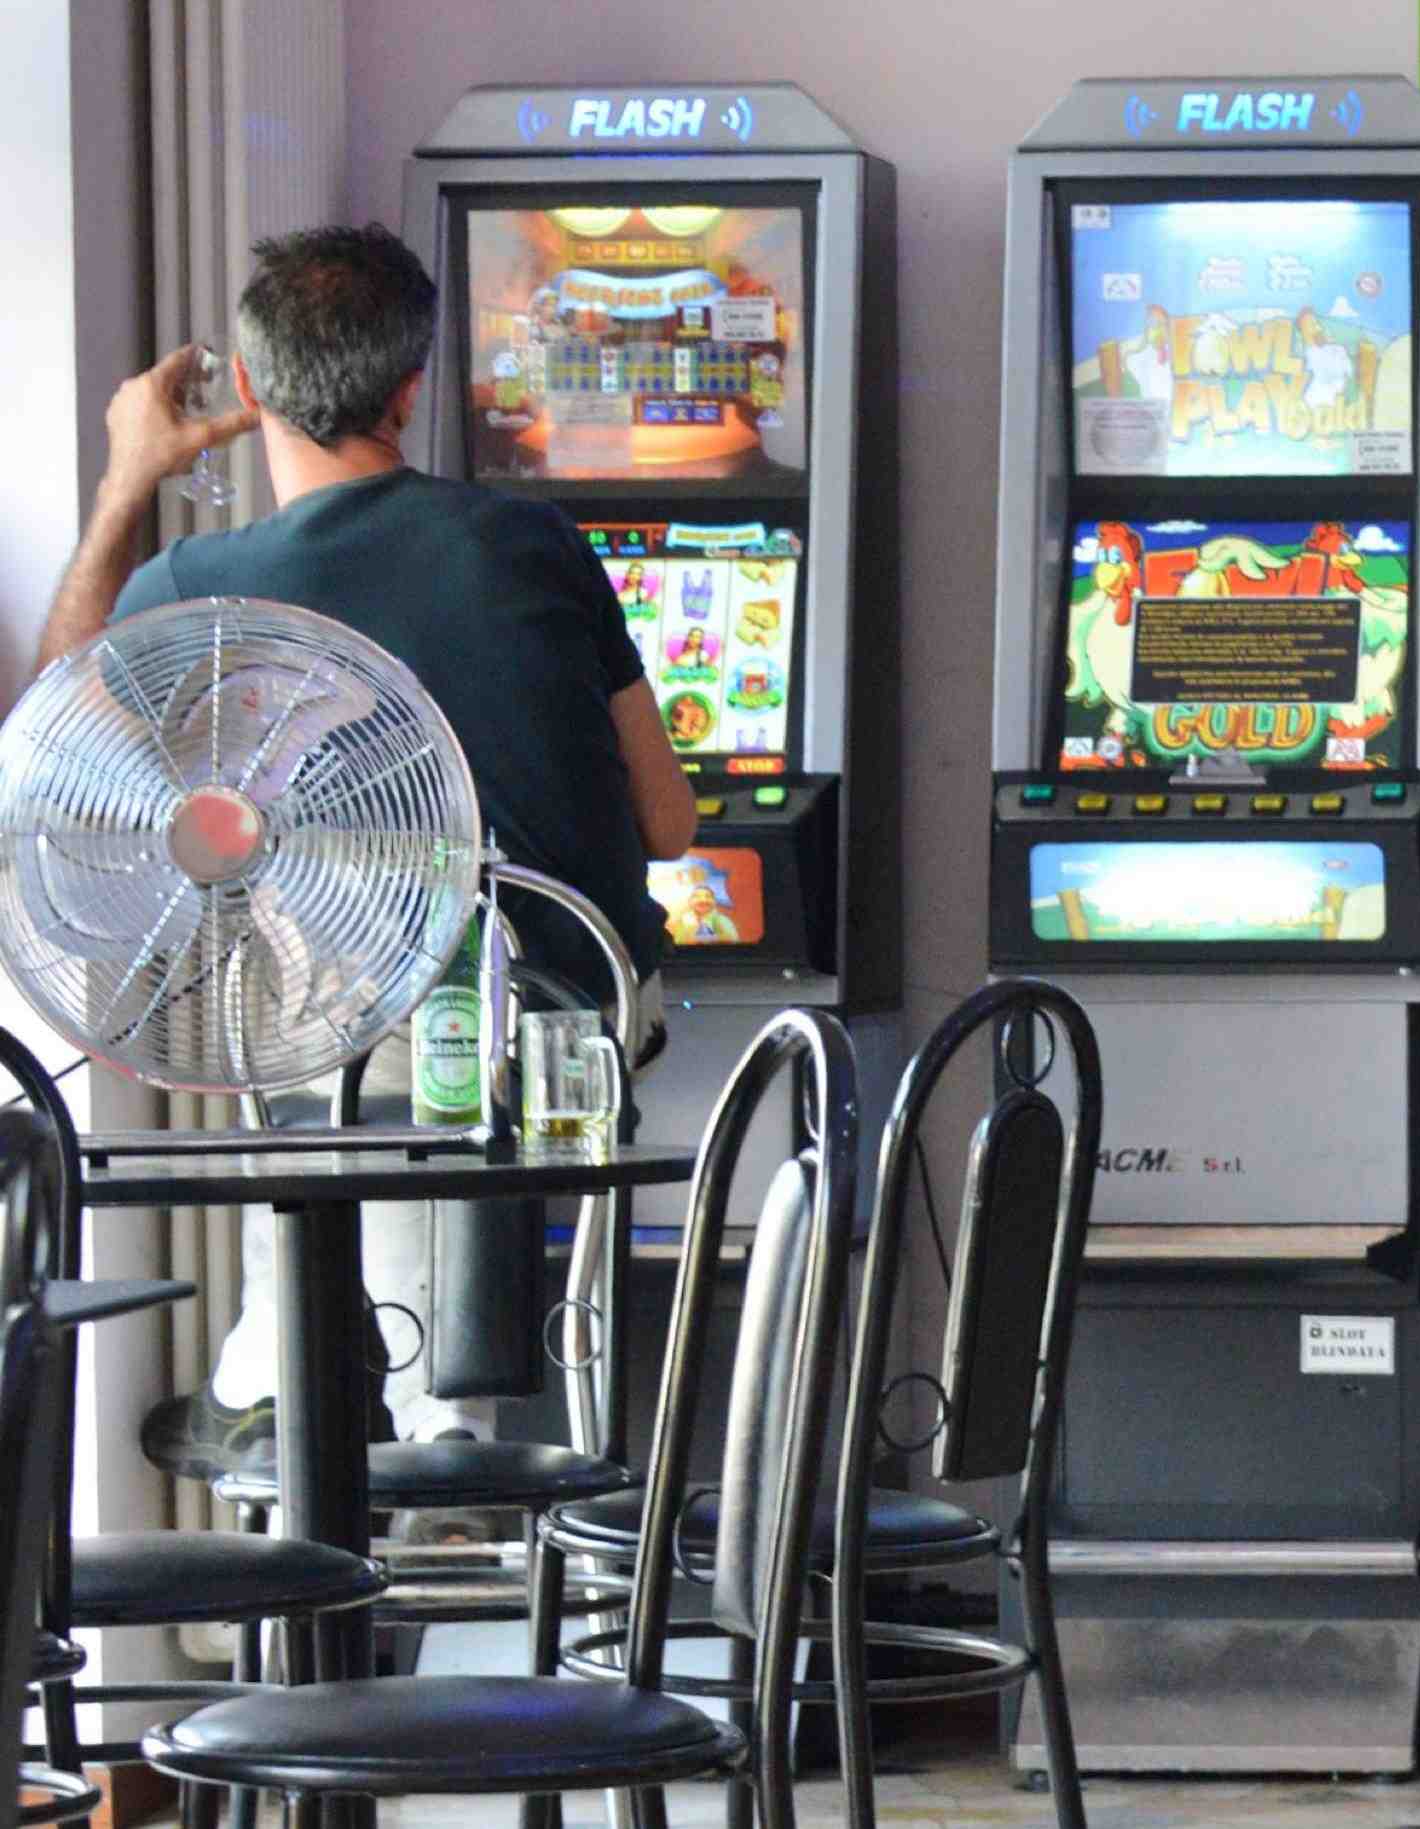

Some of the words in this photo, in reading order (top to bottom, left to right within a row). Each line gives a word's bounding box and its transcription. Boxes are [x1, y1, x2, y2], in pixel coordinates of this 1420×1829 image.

[568, 98, 706, 138] FLASH
[1176, 92, 1315, 132] FLASH
[1154, 702, 1315, 750] GOLD
[1095, 1148, 1185, 1174] ACM
